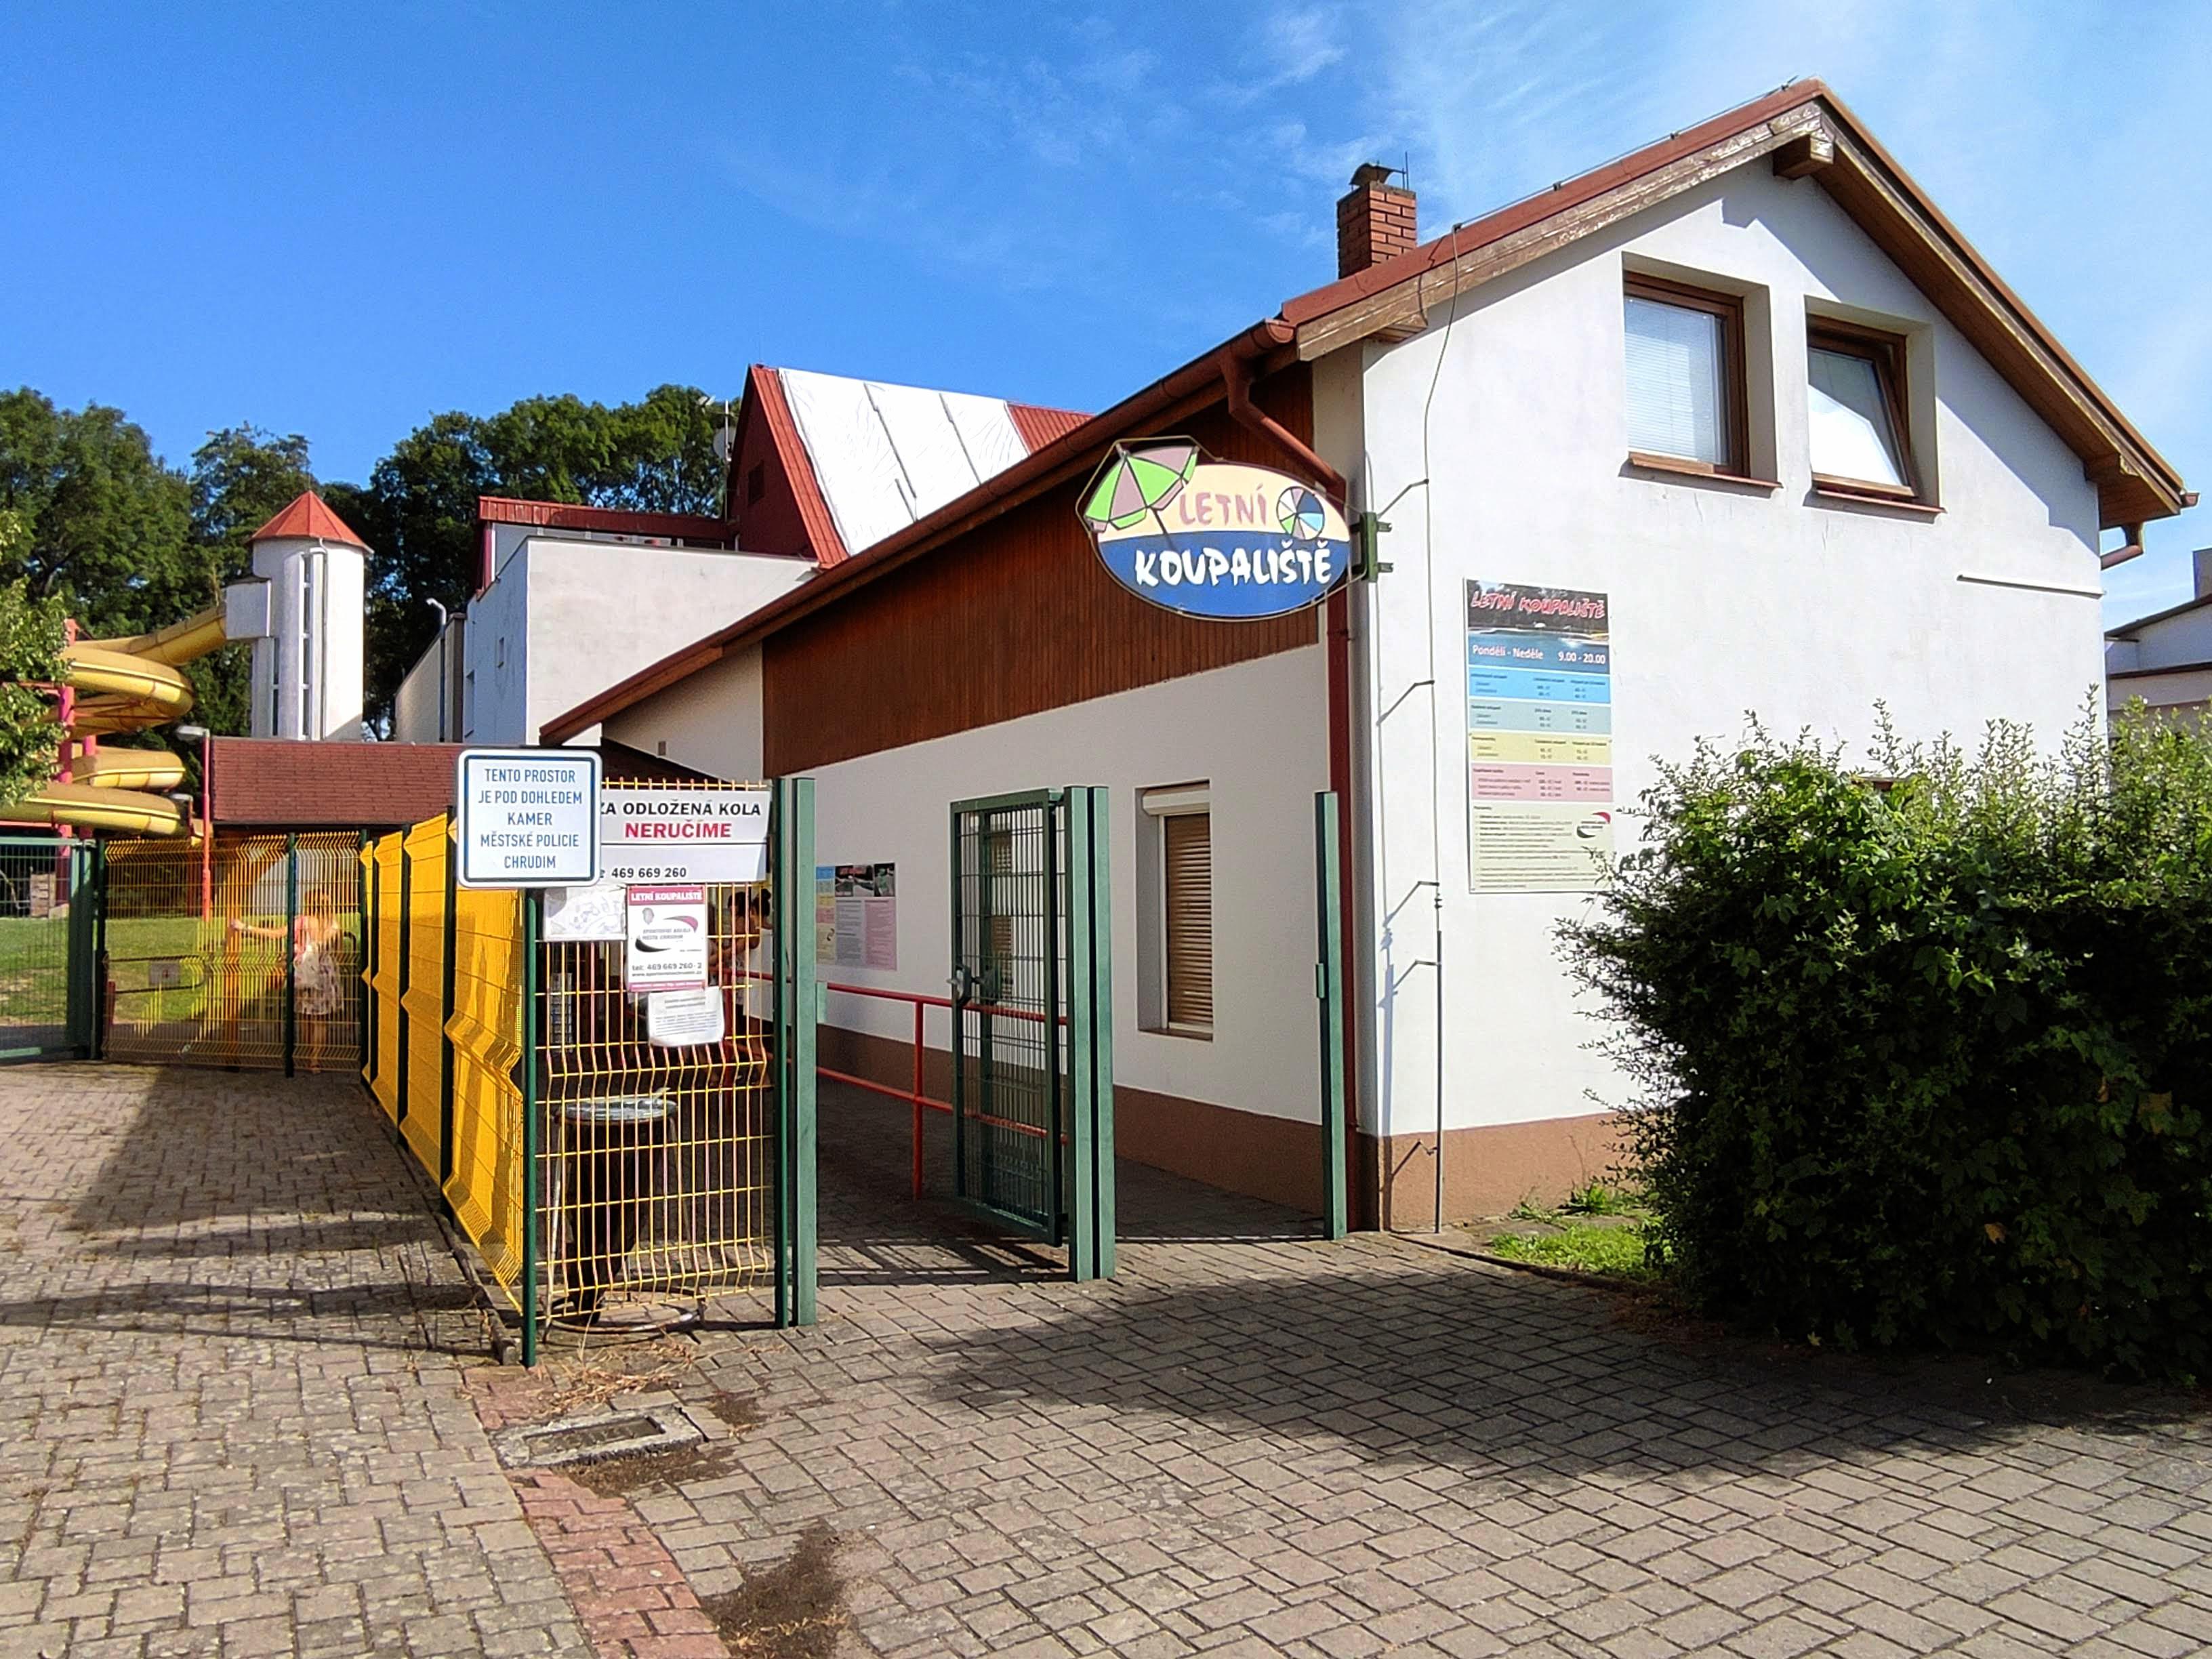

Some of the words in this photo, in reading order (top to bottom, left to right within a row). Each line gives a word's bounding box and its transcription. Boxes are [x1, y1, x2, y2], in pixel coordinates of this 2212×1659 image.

[1179, 483, 1267, 526] LETNÍ
[1134, 541, 1332, 586] KOUPALIŠTĚ
[1471, 590, 1517, 611] LETNÍ
[1519, 596, 1605, 619] KOUPALIŠTĚ
[1513, 649, 1544, 660] Neděle
[1558, 652, 1577, 662] 9.00
[1582, 653, 1606, 665] 20.00
[485, 769, 520, 782] TENTO
[525, 769, 575, 783] PROSTOR
[478, 790, 491, 803] JE
[495, 791, 517, 804] POD
[521, 791, 582, 804] DOHLEDEM
[623, 799, 714, 815] ODLOŽENÁ
[719, 803, 760, 816] KOLA
[508, 813, 552, 825] KAMER
[625, 819, 732, 838] NERUČÍME
[480, 831, 533, 847] MĚSTSKÉ
[536, 834, 579, 847] POLICIE
[504, 855, 556, 868] CHRUDIM
[611, 867, 634, 878] 469
[638, 867, 660, 878] 669
[664, 867, 687, 878] 260
